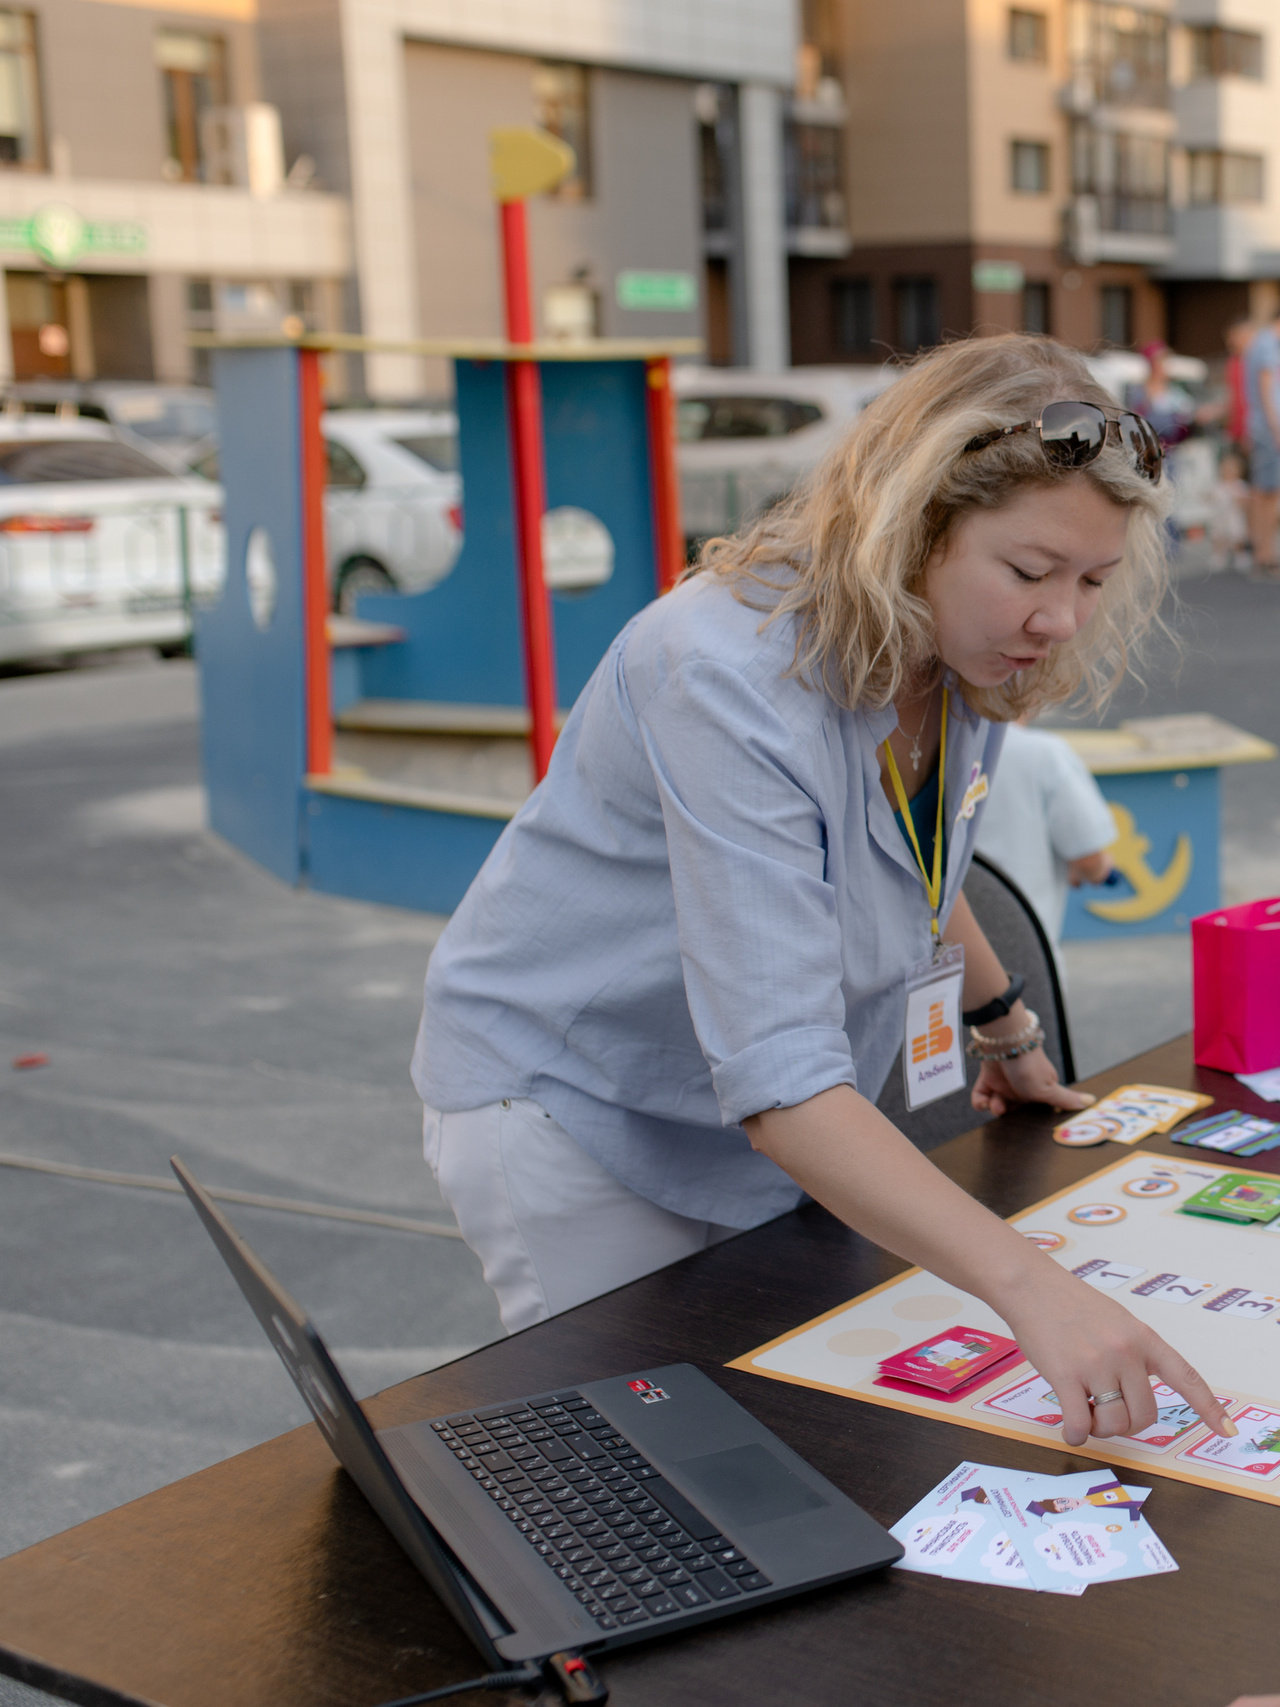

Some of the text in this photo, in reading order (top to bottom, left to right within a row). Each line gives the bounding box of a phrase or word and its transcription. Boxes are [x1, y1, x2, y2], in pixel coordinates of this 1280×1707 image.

[1100, 1270, 1130, 1279] 1
[1166, 1284, 1204, 1297] 2
[1213, 1289, 1247, 1311] НЕДЕЛЯ
[1238, 1300, 1274, 1313] 3
